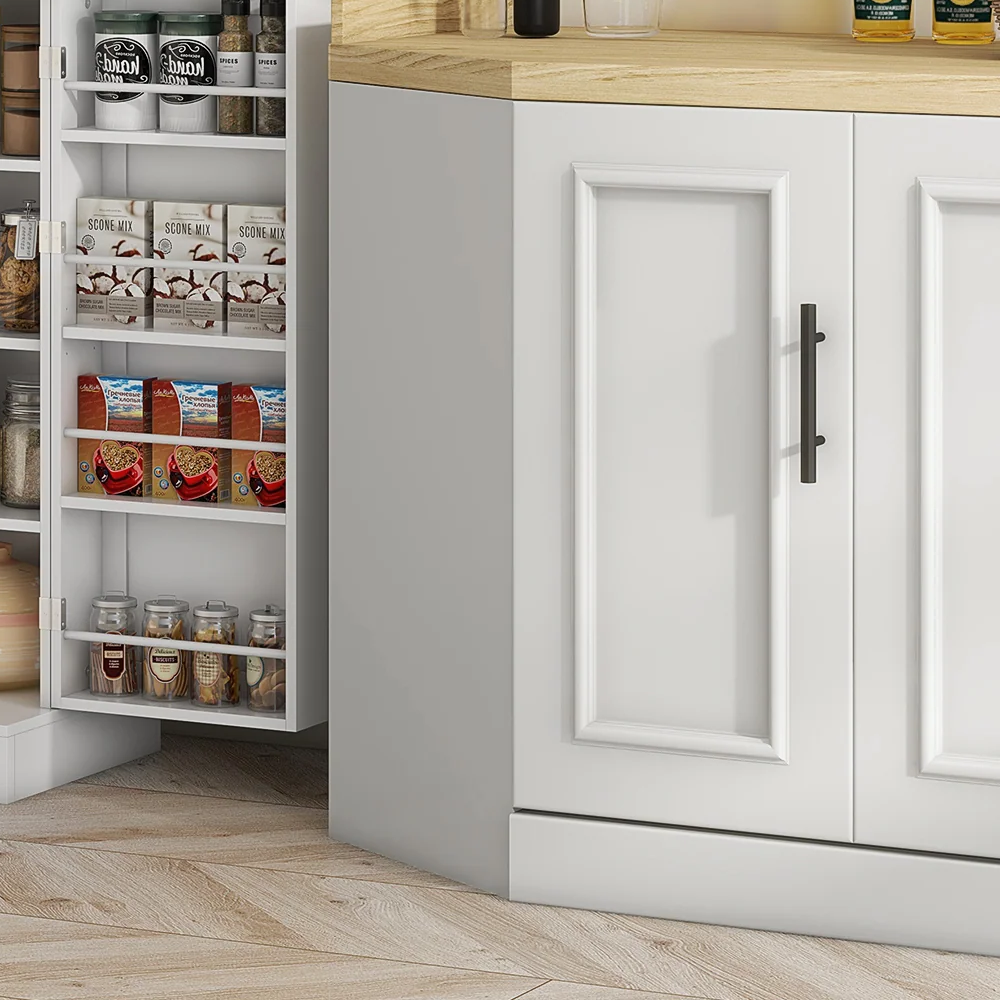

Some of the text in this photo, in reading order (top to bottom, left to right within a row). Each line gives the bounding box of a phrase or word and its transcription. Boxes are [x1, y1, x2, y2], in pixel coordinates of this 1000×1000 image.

[88, 218, 133, 232] SCONE MIX
[164, 222, 211, 236] SCONE MIX
[239, 226, 286, 239] SCONE MIX
